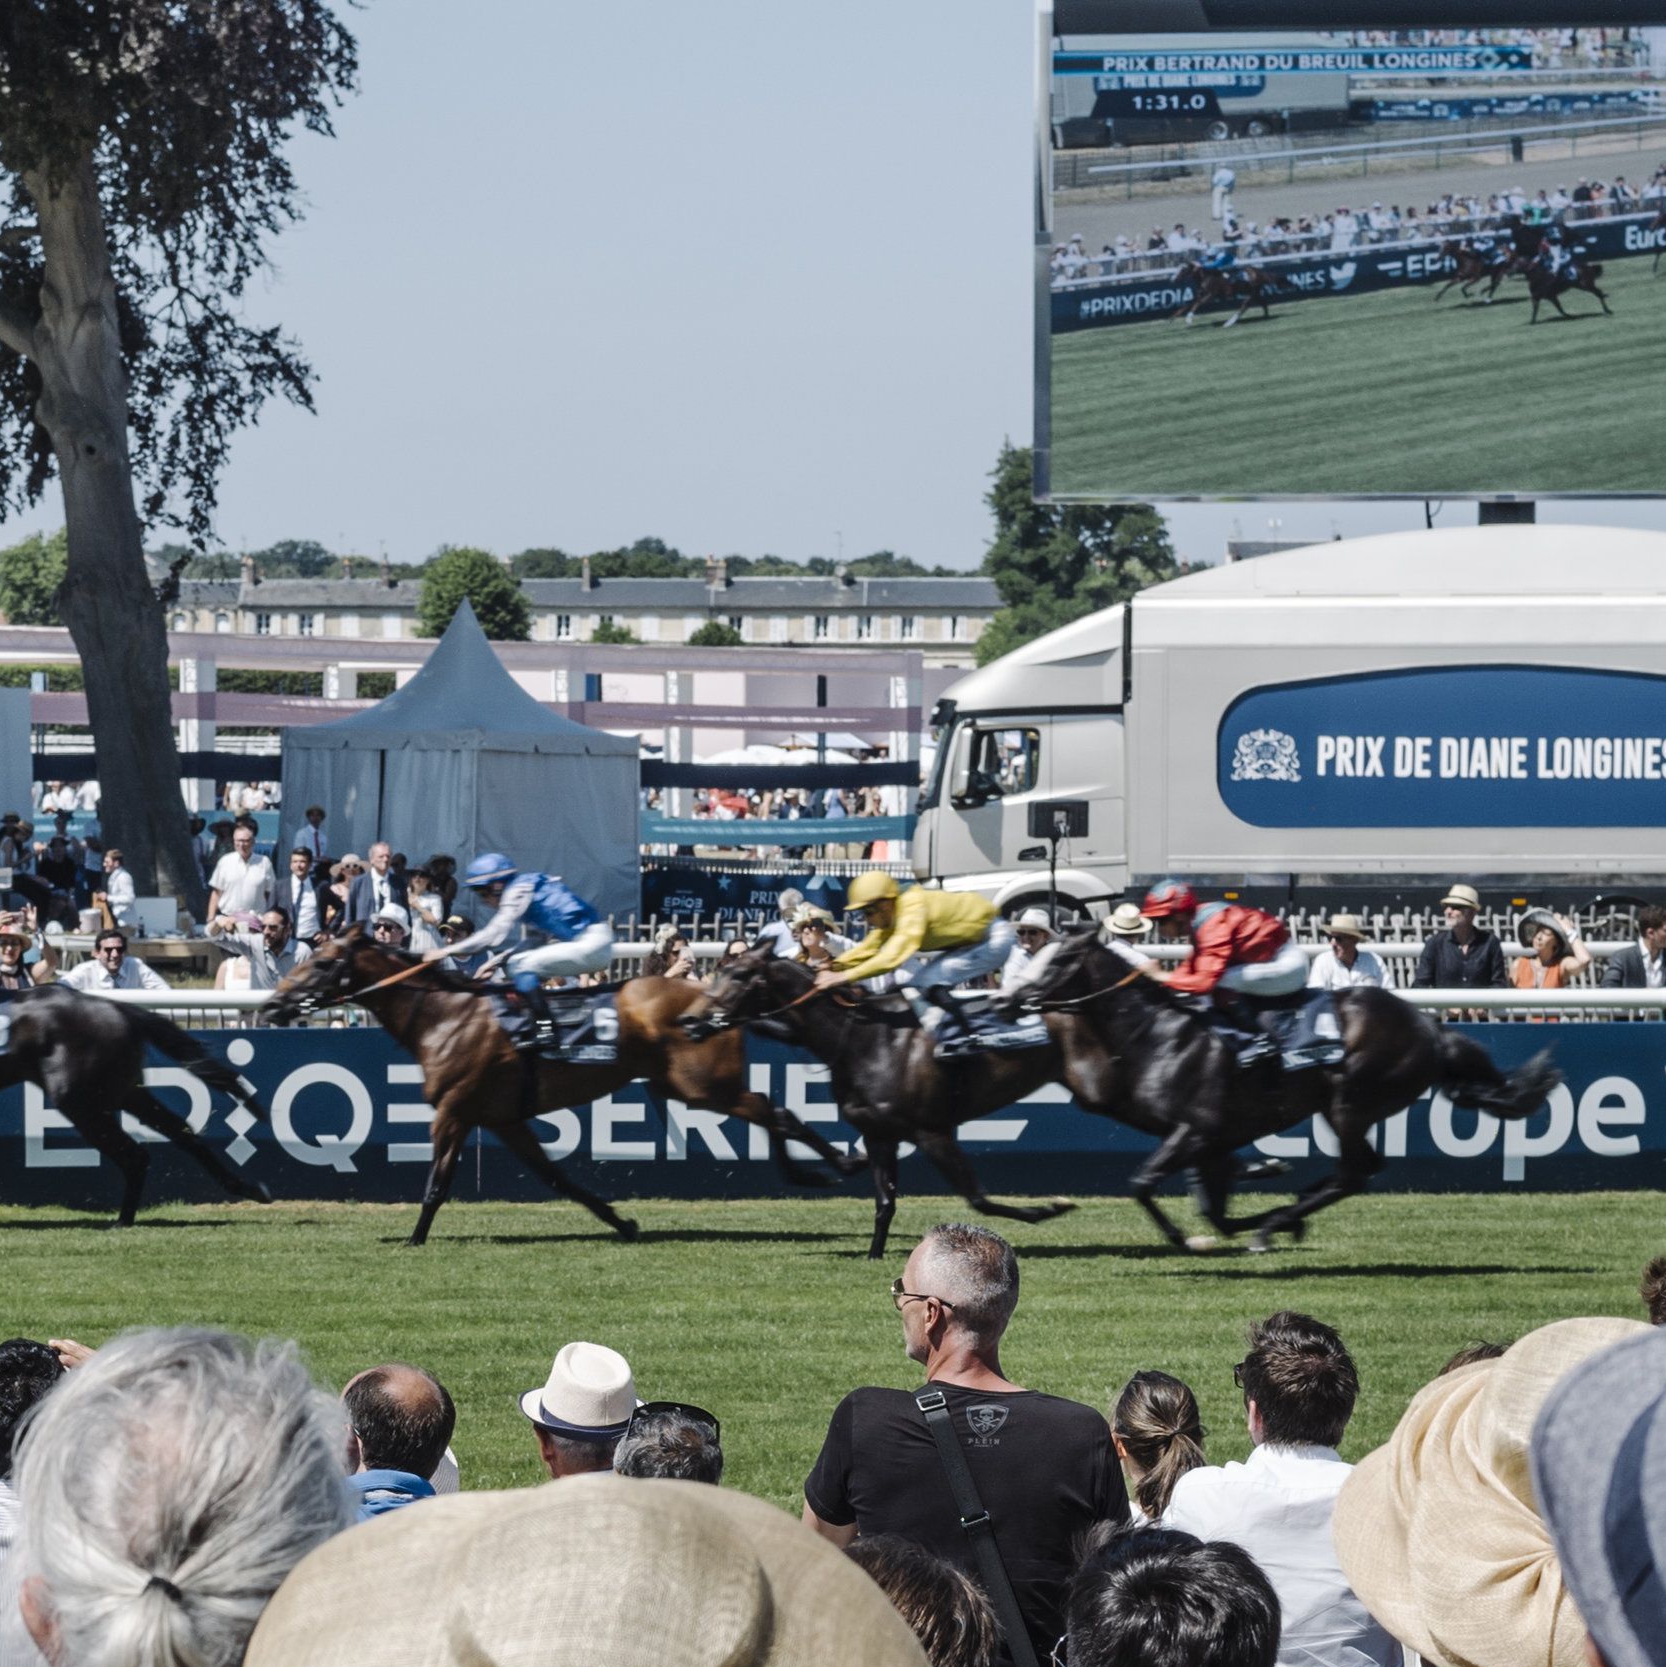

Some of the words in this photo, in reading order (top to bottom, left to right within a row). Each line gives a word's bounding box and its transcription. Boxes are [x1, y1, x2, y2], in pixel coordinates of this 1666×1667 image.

[1102, 56, 1148, 71] PRIX
[1154, 55, 1260, 71] BERTRAND
[1264, 54, 1293, 70] DU
[1298, 53, 1368, 70] BREUIL
[1372, 52, 1477, 69] LONGINES
[1132, 94, 1206, 110] 1:31.0
[1316, 735, 1386, 778] PRIX
[1393, 736, 1432, 779] DE
[1439, 736, 1529, 779] DIANE
[593, 1007, 619, 1040] 5
